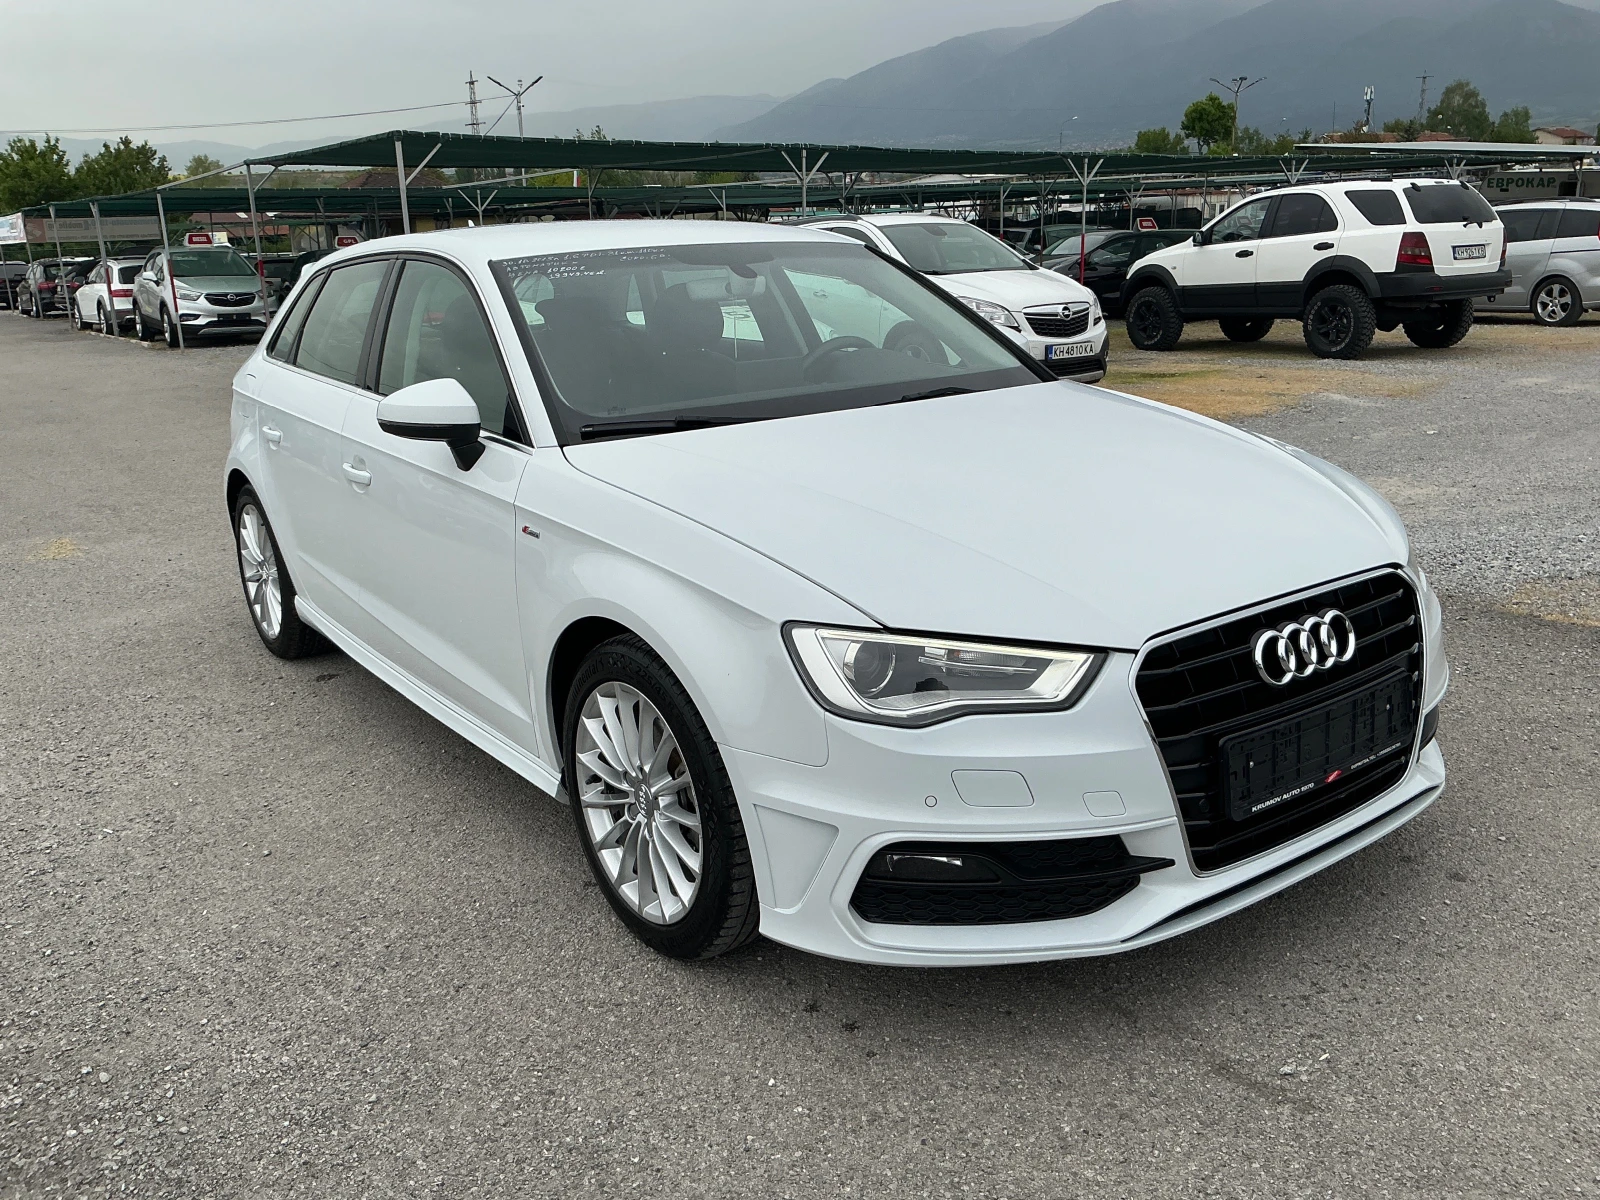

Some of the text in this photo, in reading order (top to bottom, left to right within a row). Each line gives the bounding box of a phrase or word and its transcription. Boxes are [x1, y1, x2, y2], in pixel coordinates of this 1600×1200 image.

[1487, 177, 1557, 189] ЕВРОКАР
[1251, 795, 1282, 813] KRUMOV
[1281, 788, 1301, 801] AUTO
